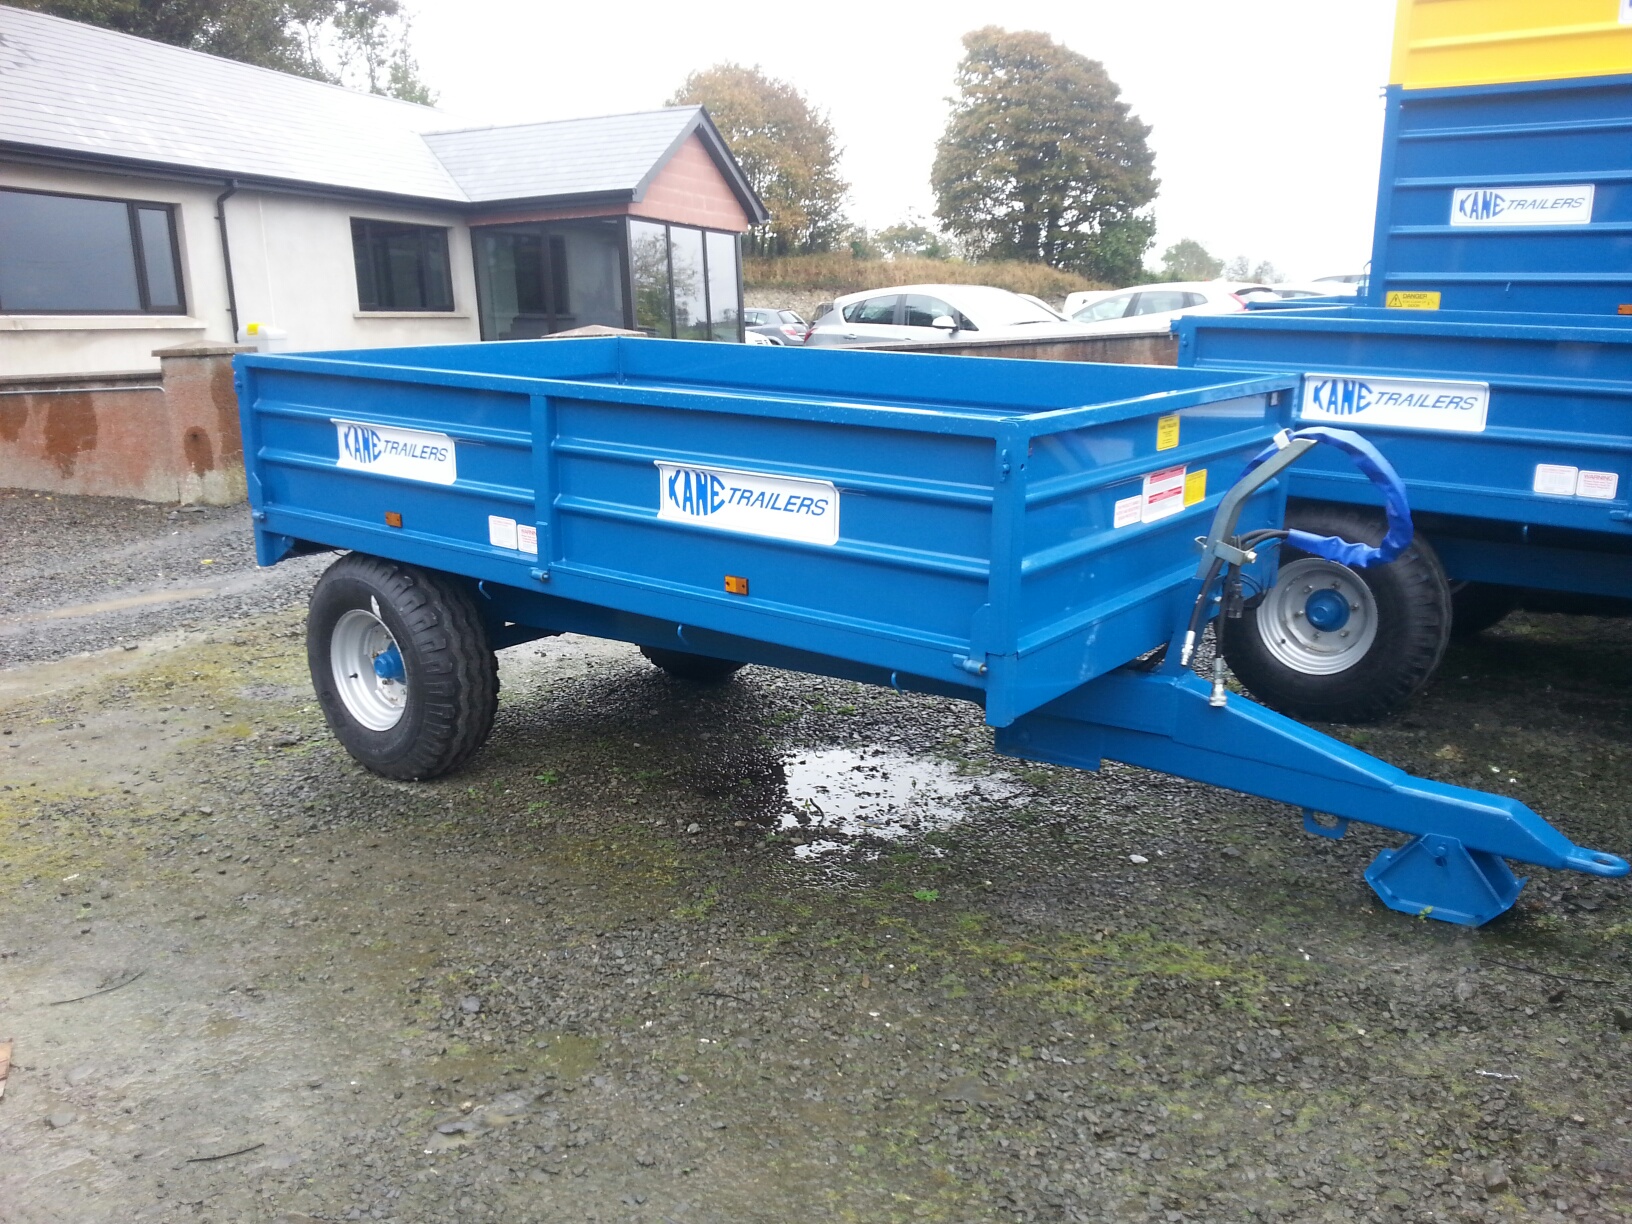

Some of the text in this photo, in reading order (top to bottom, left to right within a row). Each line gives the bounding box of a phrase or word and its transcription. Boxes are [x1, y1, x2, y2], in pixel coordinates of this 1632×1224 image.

[1459, 190, 1585, 220] KANE TRAILERS
[1313, 379, 1478, 415] KANE TRAILERS
[344, 425, 448, 464] KANE TRAILERS
[668, 469, 829, 516] KANE TRAILERS
